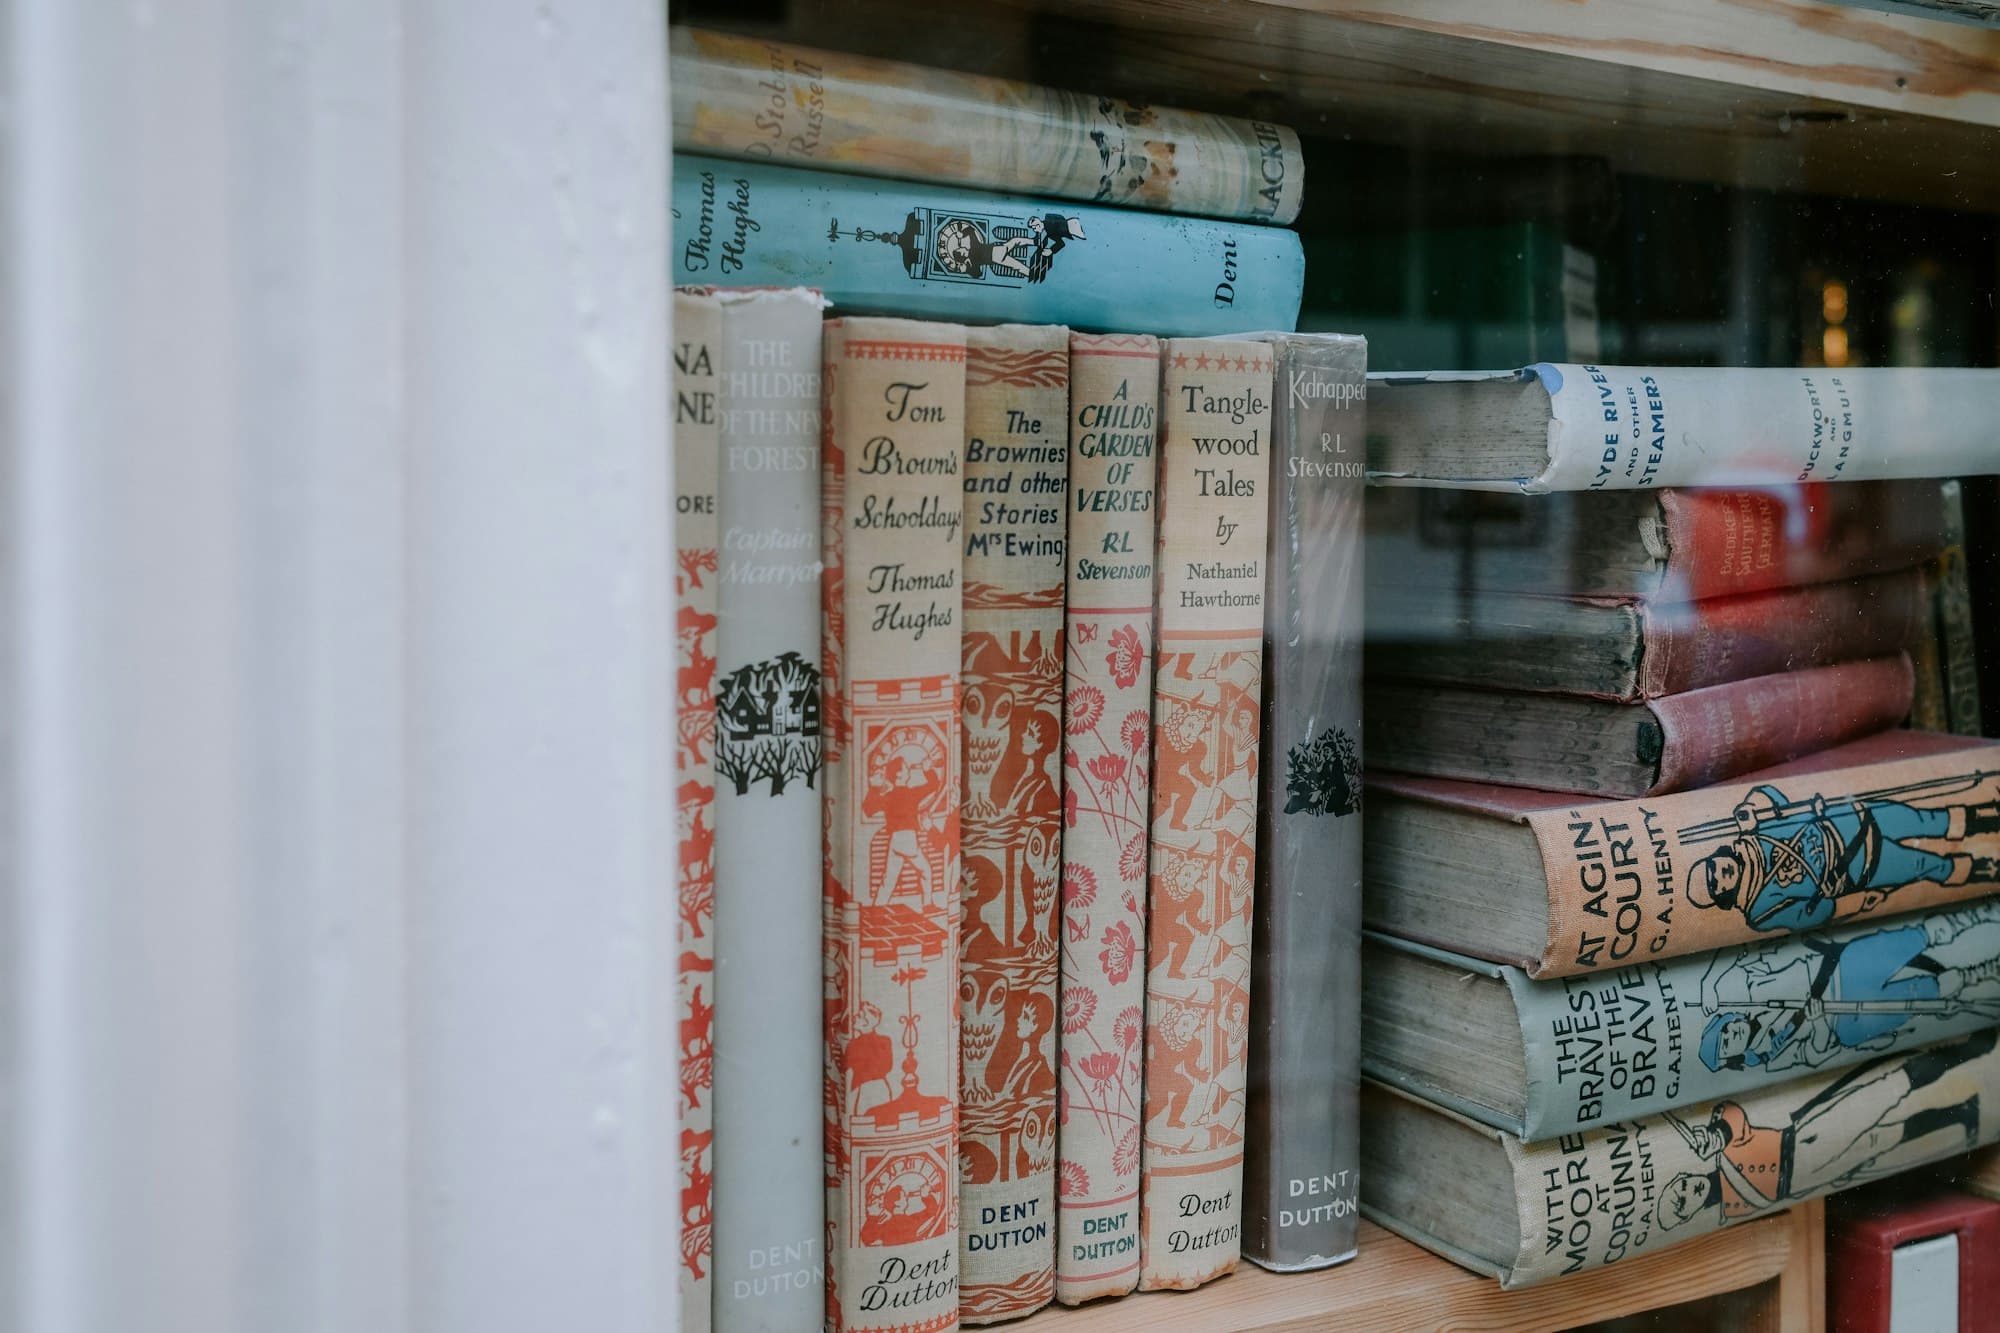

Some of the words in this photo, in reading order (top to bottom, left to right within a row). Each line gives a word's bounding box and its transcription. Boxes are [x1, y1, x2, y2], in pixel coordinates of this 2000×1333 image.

[786, 58, 825, 158] Russell
[1249, 121, 1285, 221] LACKIE
[684, 171, 715, 273] Thomas
[720, 178, 760, 274] Hughes
[1215, 239, 1239, 310] Dent
[741, 340, 792, 366] THE
[885, 382, 946, 424] Tom
[1113, 379, 1128, 402] A
[1181, 385, 1269, 424] Tangle-
[744, 411, 781, 435] THE
[1006, 410, 1042, 435] The
[1079, 402, 1154, 430] CHILD'S
[1625, 385, 1641, 438] OTHER
[1191, 430, 1259, 457] wood
[1638, 375, 1666, 486] STEAMERS
[1797, 377, 1823, 482] DUCKWORTH
[1824, 377, 1854, 481] LANGMUIR
[1829, 417, 1837, 442] AND
[728, 447, 819, 473] FOREST
[859, 436, 957, 476] Brown's
[967, 438, 1066, 464] Brownies
[1079, 433, 1153, 459] GARDEN
[1106, 463, 1133, 485] OF
[1287, 456, 1366, 479] Stevenson
[1588, 433, 1618, 491] LYDE
[1624, 447, 1640, 478] AND
[963, 472, 1010, 494] and
[1020, 471, 1067, 494] other
[1194, 469, 1255, 498] Tales
[980, 502, 1058, 525] Stories
[1077, 489, 1152, 513] VERSES
[724, 527, 813, 555] Captain
[1215, 516, 1239, 546] by
[1005, 532, 1066, 566] Ewing
[867, 563, 954, 595] Thomas
[1077, 558, 1151, 581] Stevenson
[1186, 560, 1259, 581] Nathaniel
[1179, 590, 1261, 608] Hawthorne
[872, 603, 952, 642] Hughes
[1600, 817, 1642, 960] COURT
[1575, 932, 1606, 967] AT
[1600, 986, 1626, 1046] THE
[1617, 966, 1656, 1101] BRAVE
[1552, 1016, 1577, 1084] THE
[1609, 1051, 1628, 1090] OF
[1290, 1170, 1349, 1197] DENT
[1595, 1183, 1610, 1213] AT
[982, 1199, 1039, 1225] DENT
[1180, 1191, 1232, 1218] Dent
[1280, 1196, 1357, 1229] DUTTON
[1544, 1167, 1564, 1255] WITH
[1559, 1132, 1593, 1276] MOORE
[968, 1222, 1047, 1252] DUTTON
[1083, 1212, 1128, 1235] DENT
[750, 1238, 816, 1270] DENT
[1072, 1234, 1135, 1261] DUTTON
[1167, 1224, 1239, 1255] Dutton
[878, 1249, 951, 1285] Dent
[859, 1274, 959, 1311] Dutton
